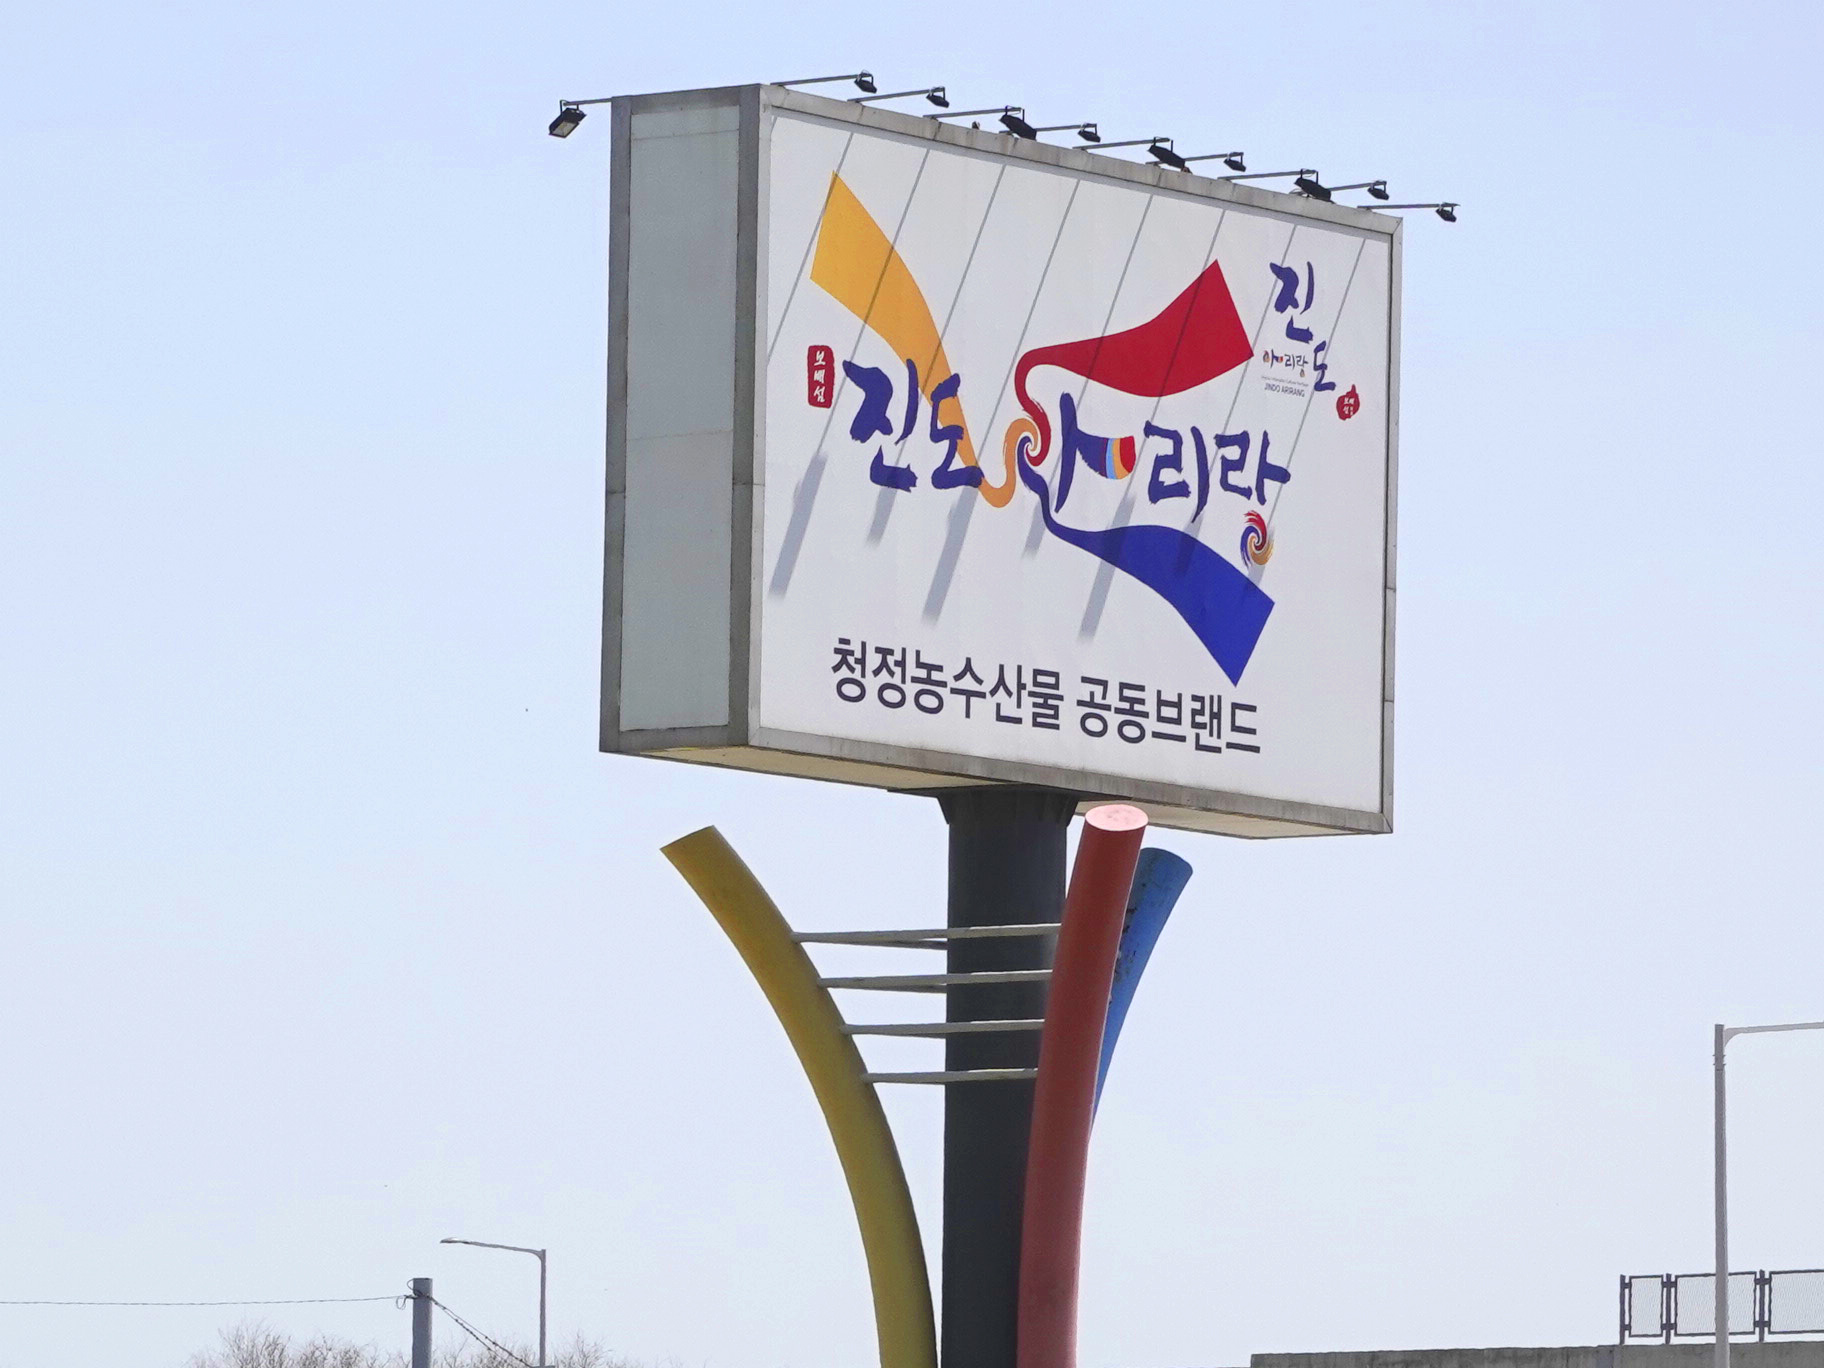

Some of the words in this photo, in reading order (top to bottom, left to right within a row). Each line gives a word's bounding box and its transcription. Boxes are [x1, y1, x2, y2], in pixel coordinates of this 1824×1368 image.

[842, 358, 984, 493] 진도
[831, 637, 1064, 731] 청정농수산물
[1076, 675, 1261, 754] 공동브랜드
